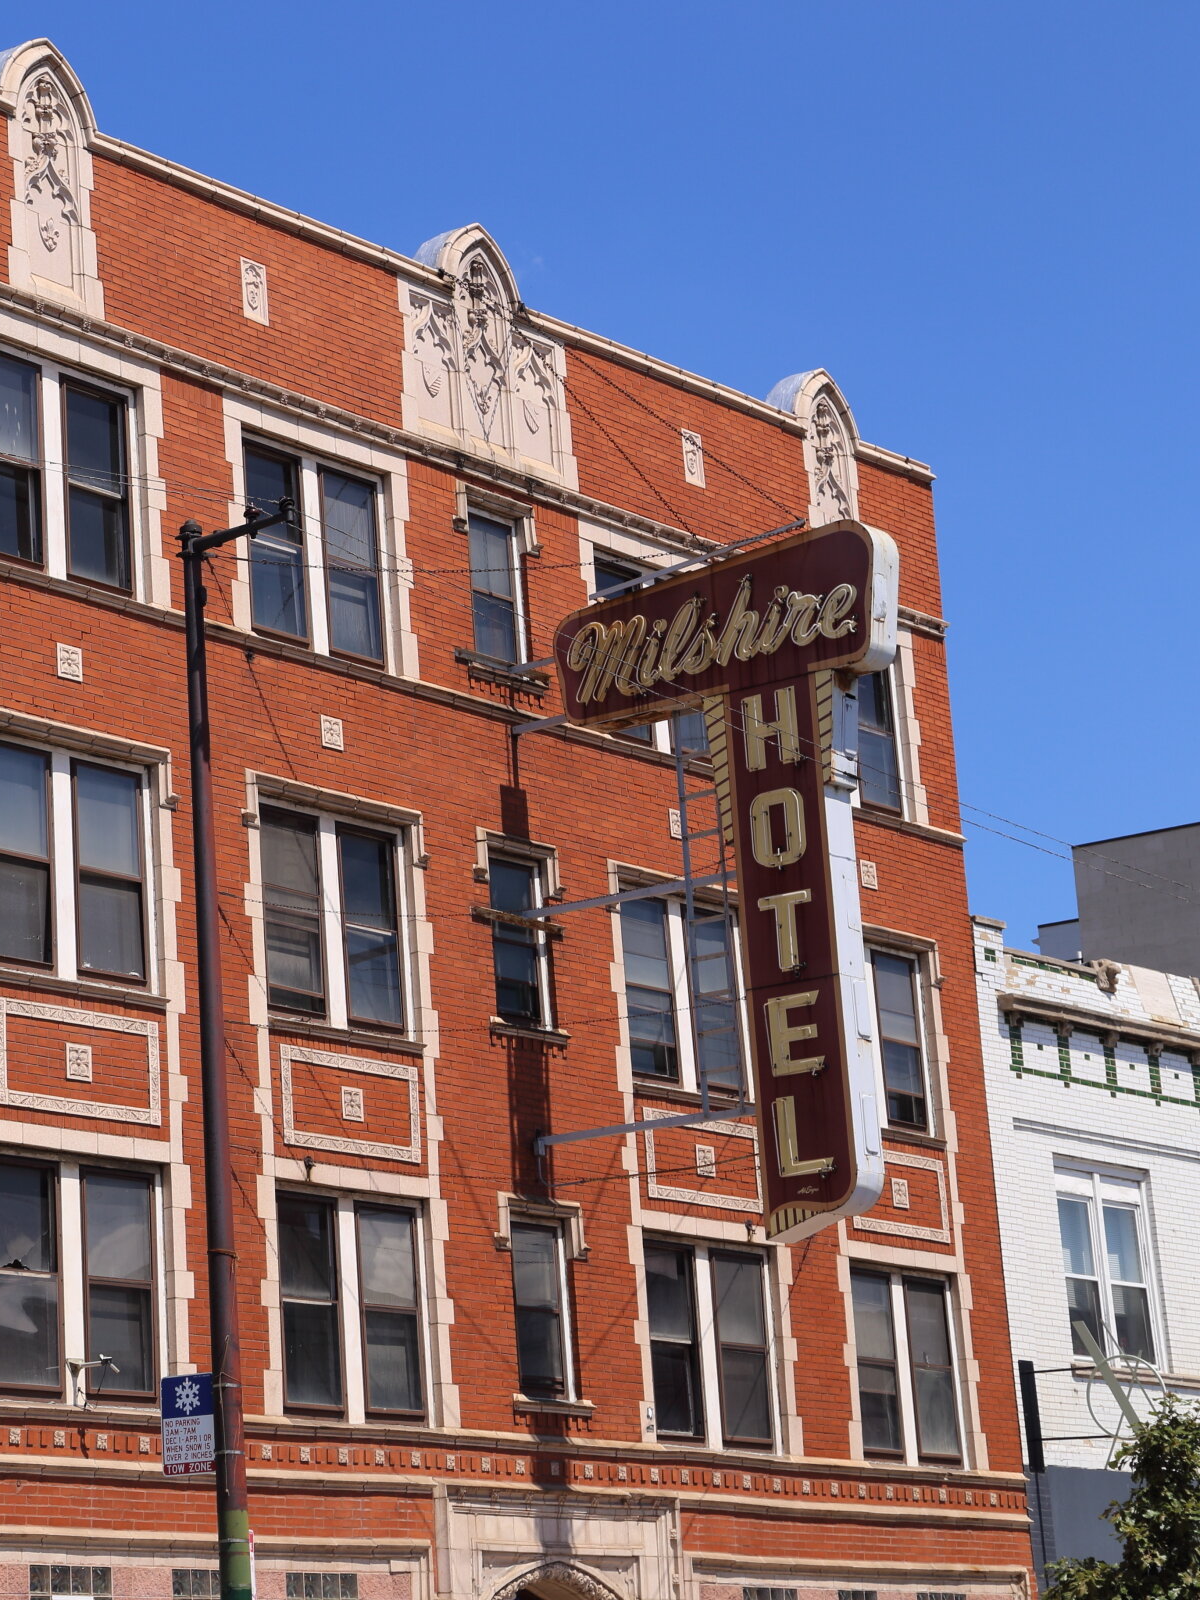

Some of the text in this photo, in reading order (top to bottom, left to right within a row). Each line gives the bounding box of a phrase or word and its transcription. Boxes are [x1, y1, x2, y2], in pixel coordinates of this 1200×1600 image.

[566, 573, 859, 705] Milshire
[741, 685, 836, 1178] HOTEL
[165, 1418, 200, 1428] NO PARKING
[165, 1437, 177, 1445] DEC
[203, 1433, 212, 1442] OR
[165, 1442, 211, 1453] WHEN SNOW IS
[166, 1450, 213, 1461] OVER 2 INCHES
[166, 1461, 213, 1474] TOW ZONE
